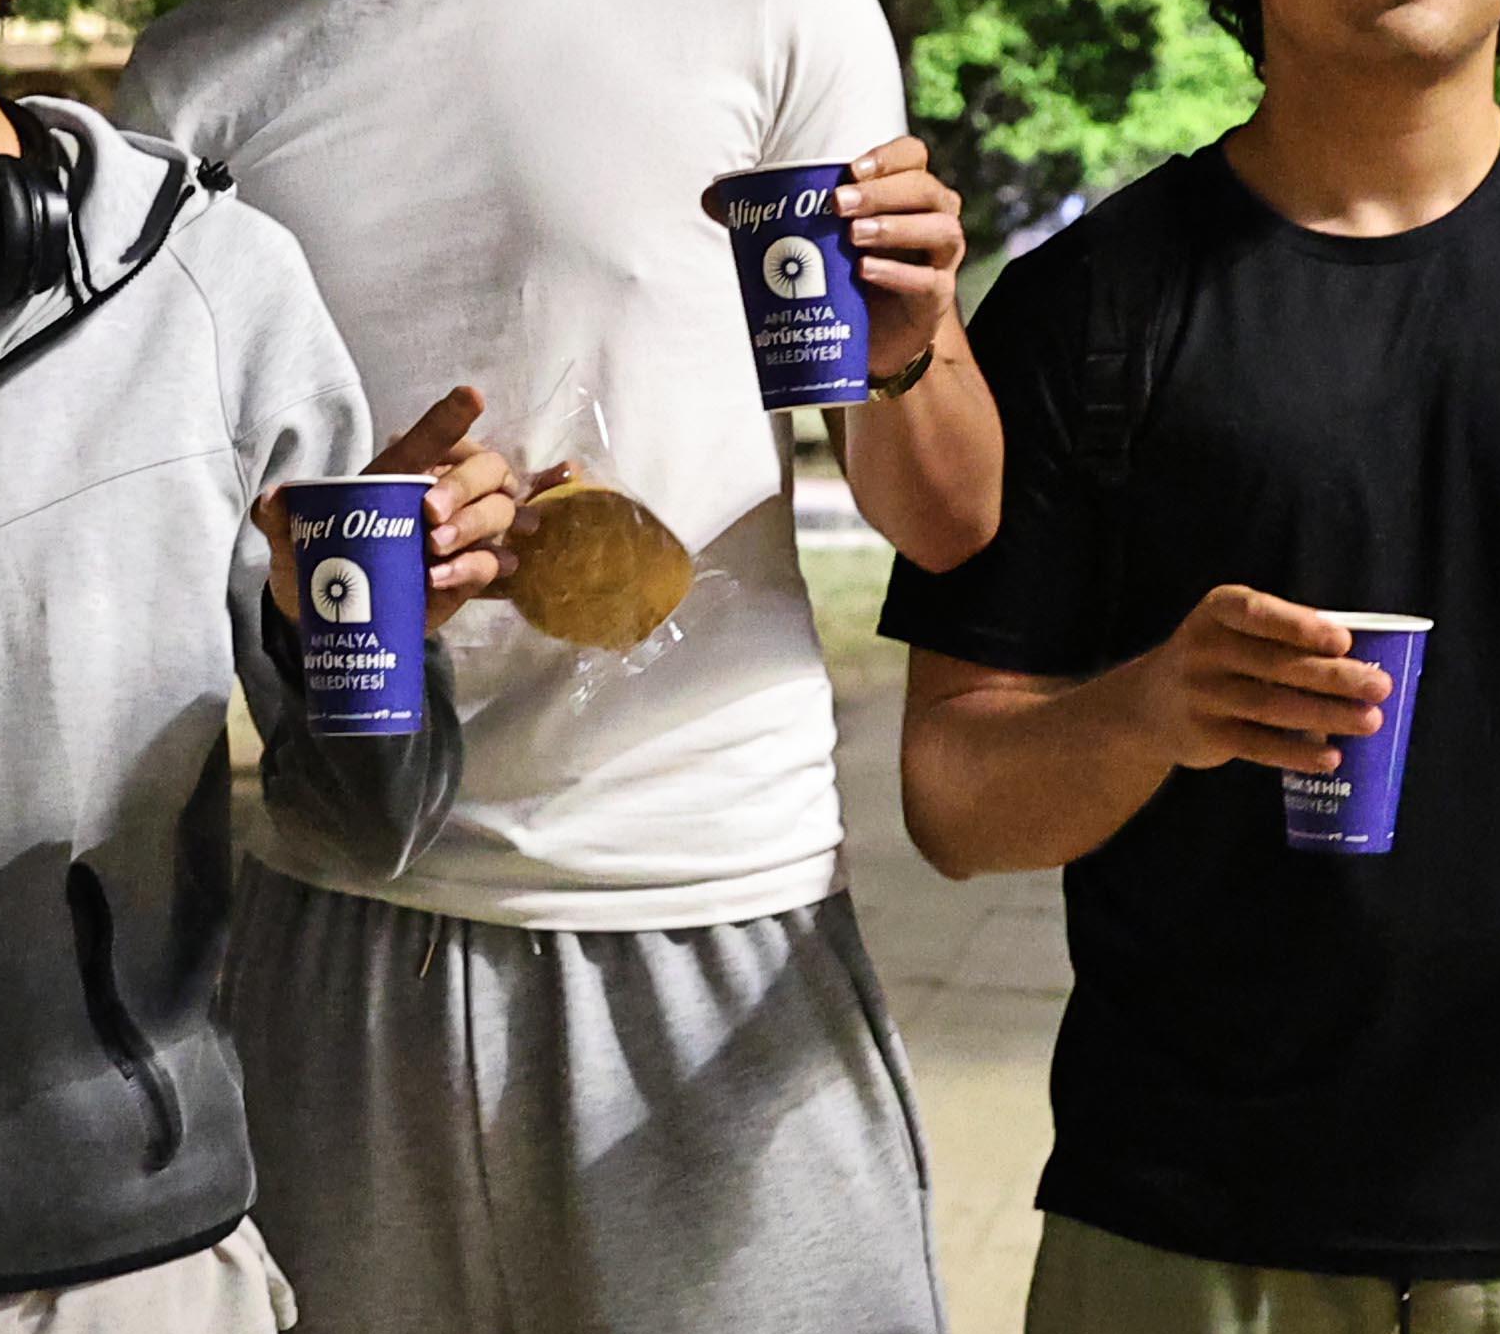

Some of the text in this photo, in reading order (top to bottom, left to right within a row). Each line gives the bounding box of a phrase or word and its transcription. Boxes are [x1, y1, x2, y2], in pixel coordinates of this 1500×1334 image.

[764, 306, 836, 325] ANTALYA
[766, 341, 842, 365] BELEDİYESİ
[342, 509, 415, 540] Olsun
